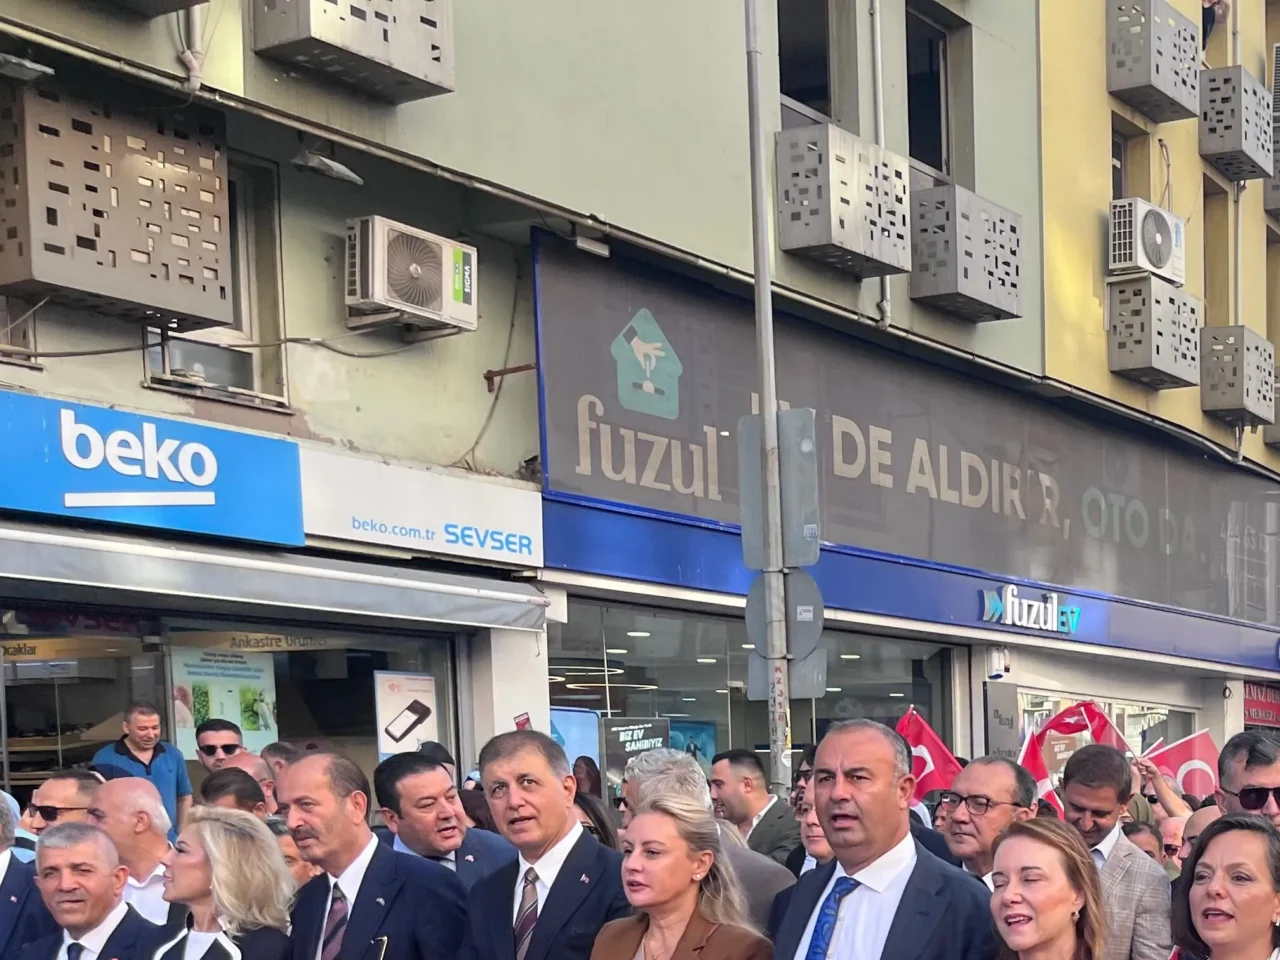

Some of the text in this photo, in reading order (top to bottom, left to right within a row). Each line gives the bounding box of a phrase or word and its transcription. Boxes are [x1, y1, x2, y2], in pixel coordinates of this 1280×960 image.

[59, 408, 218, 487] beko
[575, 393, 722, 502] fuzul
[831, 414, 895, 489] DE
[906, 437, 1071, 541] ALDIRR,
[1081, 486, 1150, 549] OTO
[352, 516, 532, 556] beko.com.tr SEVSER
[230, 634, 282, 648] Ankastre
[633, 729, 645, 740] EV
